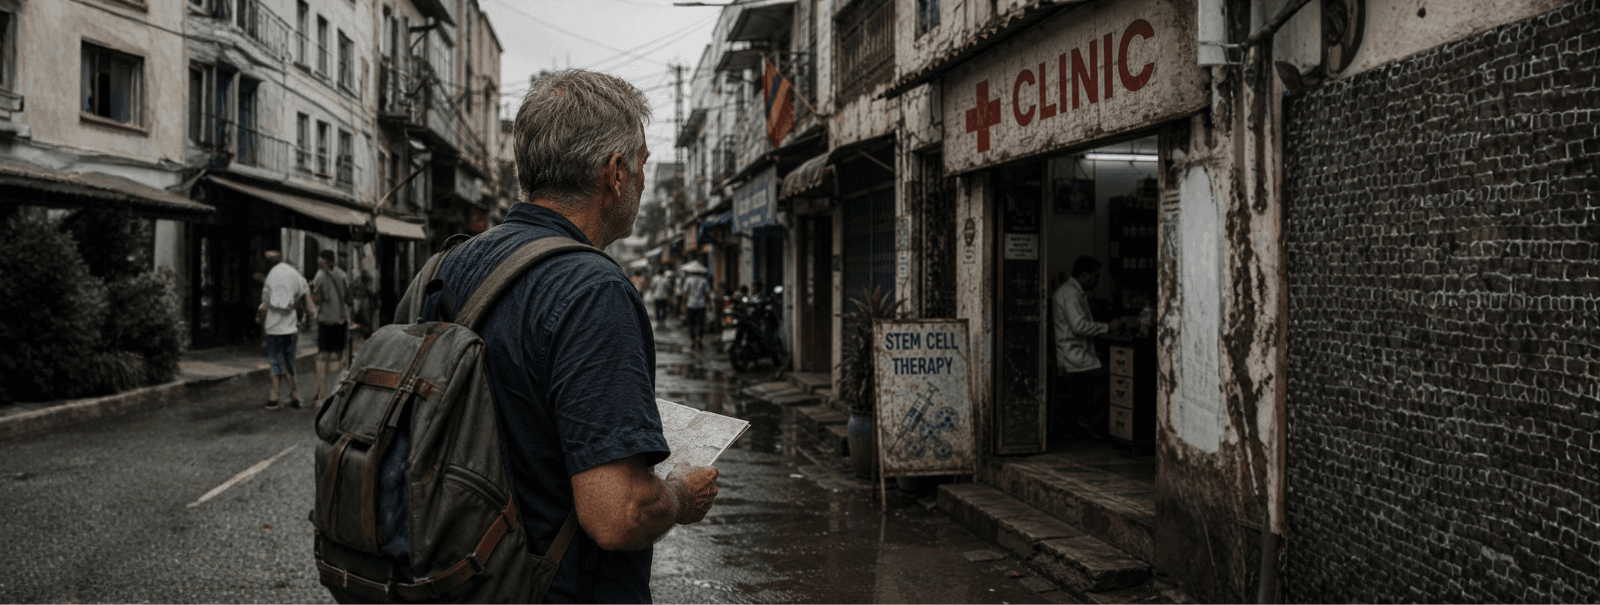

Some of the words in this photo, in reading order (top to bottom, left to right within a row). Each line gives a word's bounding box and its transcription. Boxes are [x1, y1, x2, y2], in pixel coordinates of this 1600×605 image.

[1012, 18, 1155, 127] CLINIC
[885, 332, 921, 350] STEM
[926, 332, 958, 350] CELL
[892, 357, 953, 375] THERAPY
